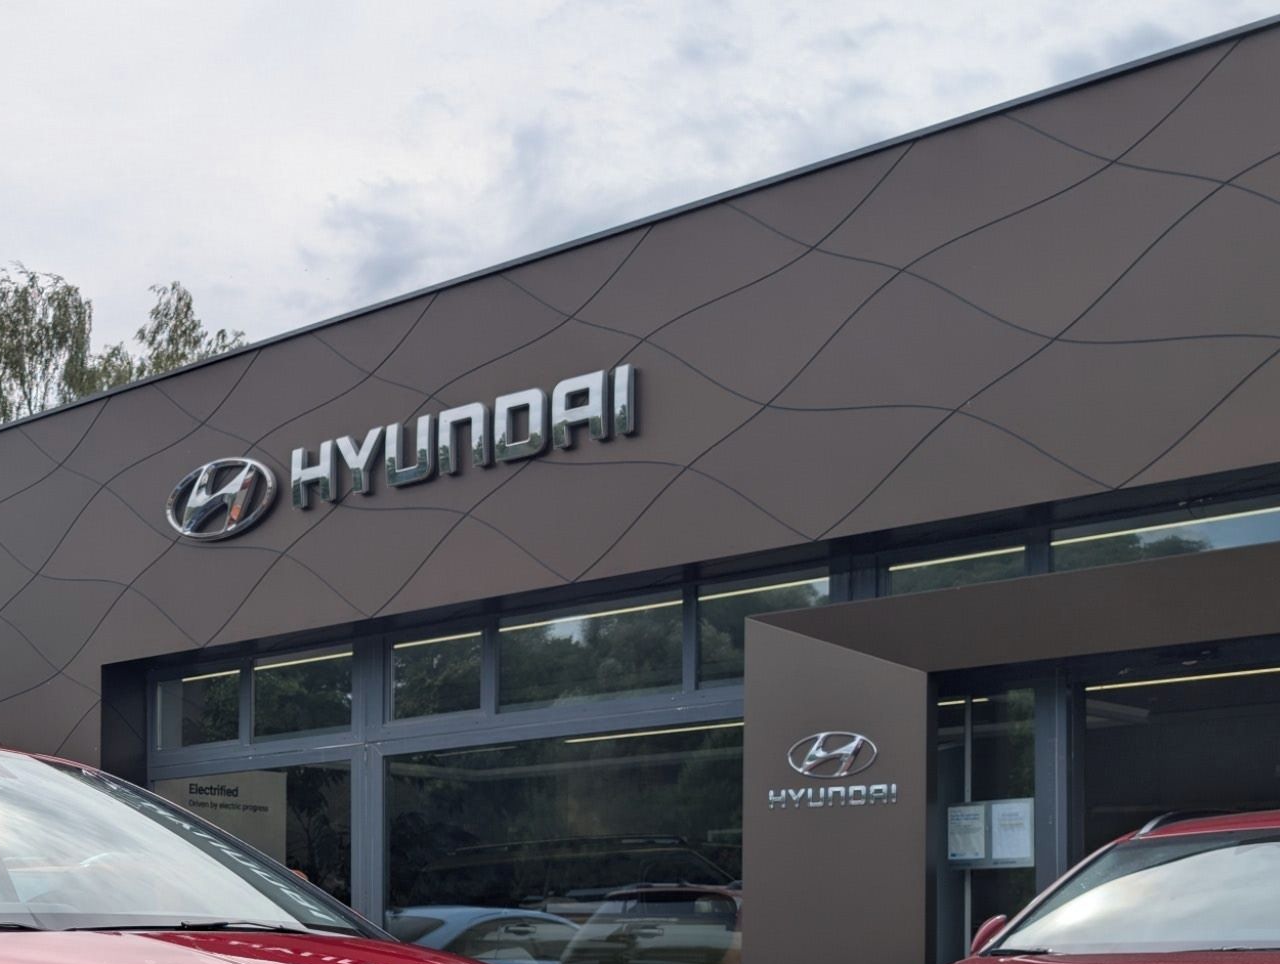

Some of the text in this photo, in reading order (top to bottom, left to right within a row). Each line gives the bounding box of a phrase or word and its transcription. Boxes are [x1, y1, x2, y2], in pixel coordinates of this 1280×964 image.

[291, 363, 637, 510] HYUNDAI
[189, 783, 239, 798] Electrified
[768, 783, 898, 809] HYUNDAI
[210, 801, 218, 810] by
